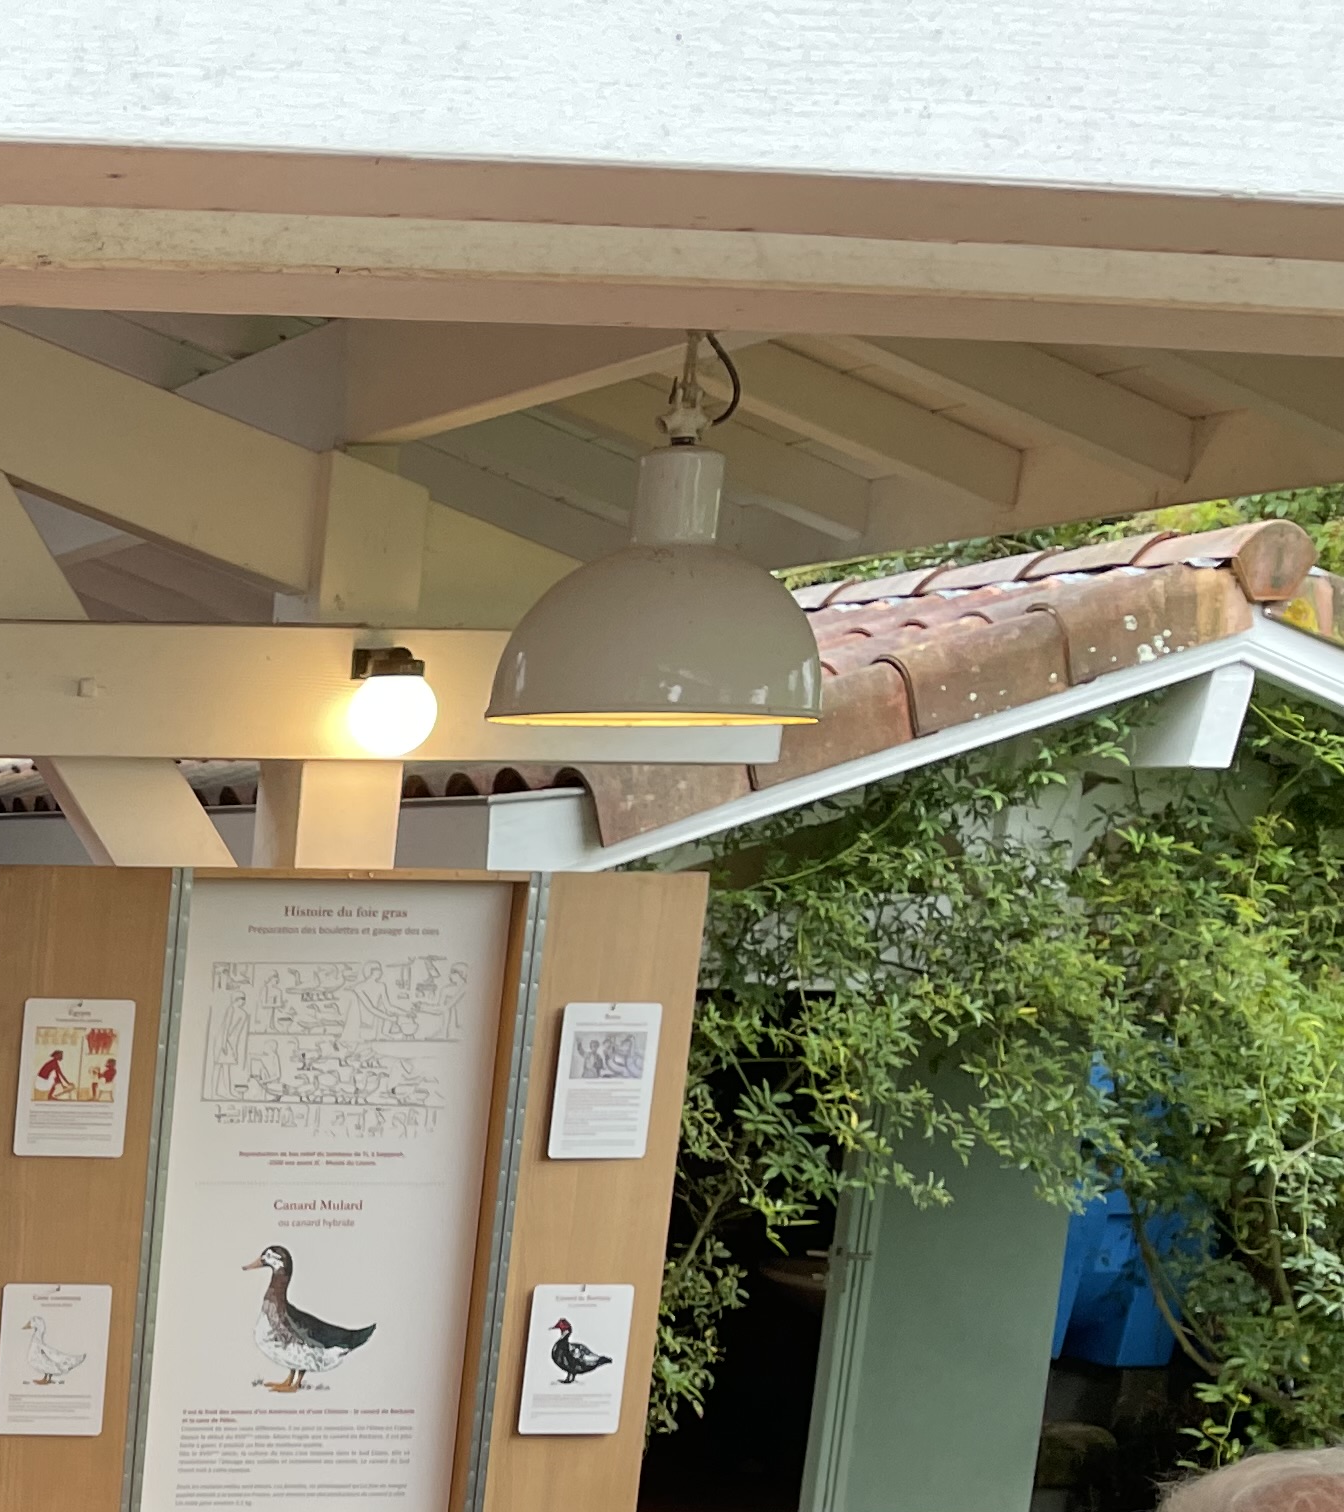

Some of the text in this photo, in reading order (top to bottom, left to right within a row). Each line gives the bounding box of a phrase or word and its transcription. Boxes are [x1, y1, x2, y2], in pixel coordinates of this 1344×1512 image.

[284, 905, 408, 921] Histoire du foie gras
[301, 925, 316, 935] des
[318, 925, 359, 936] boulettes
[274, 1200, 363, 1211] Canard Mulard
[278, 1218, 355, 1229] ou canard hybride
